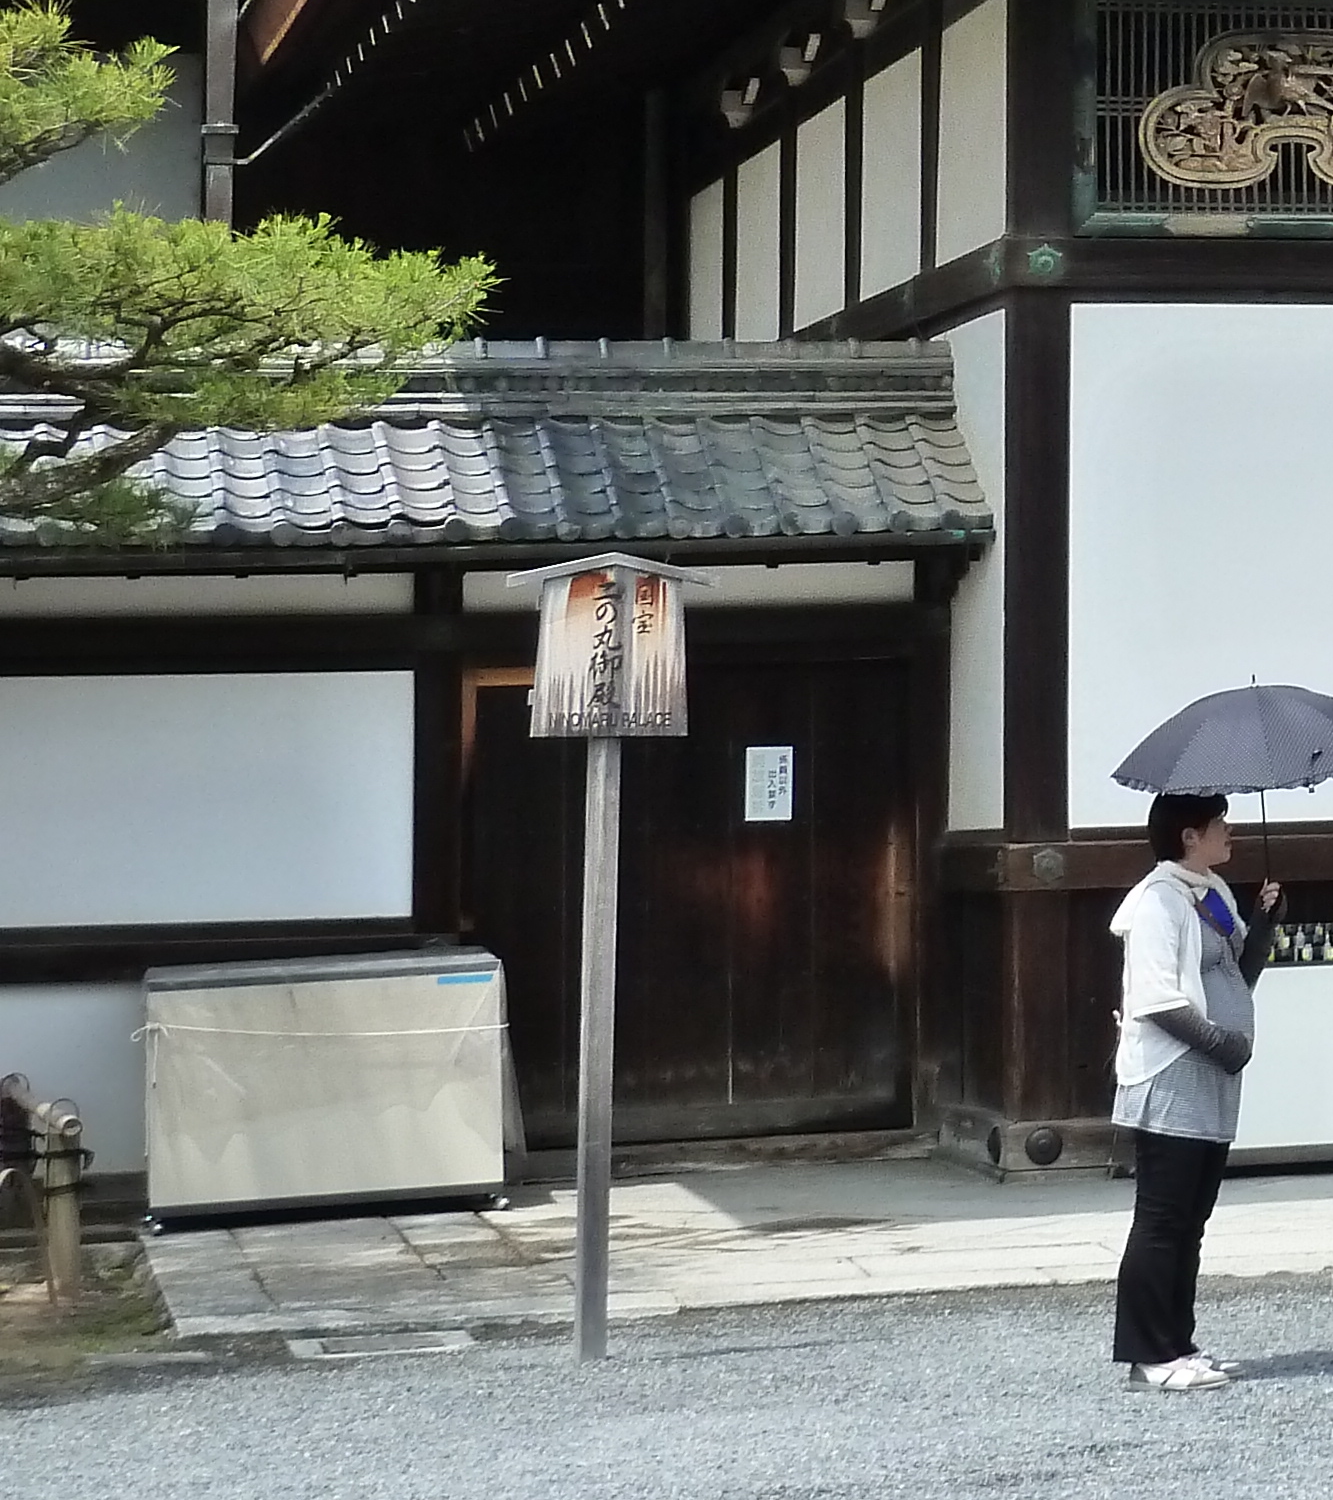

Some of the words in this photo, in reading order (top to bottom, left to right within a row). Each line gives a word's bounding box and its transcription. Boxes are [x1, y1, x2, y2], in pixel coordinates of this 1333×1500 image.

[632, 582, 655, 634] 国宝
[587, 582, 622, 707] 二の丸御殿
[549, 711, 618, 729] NINOMARU
[621, 711, 672, 728] PALACE
